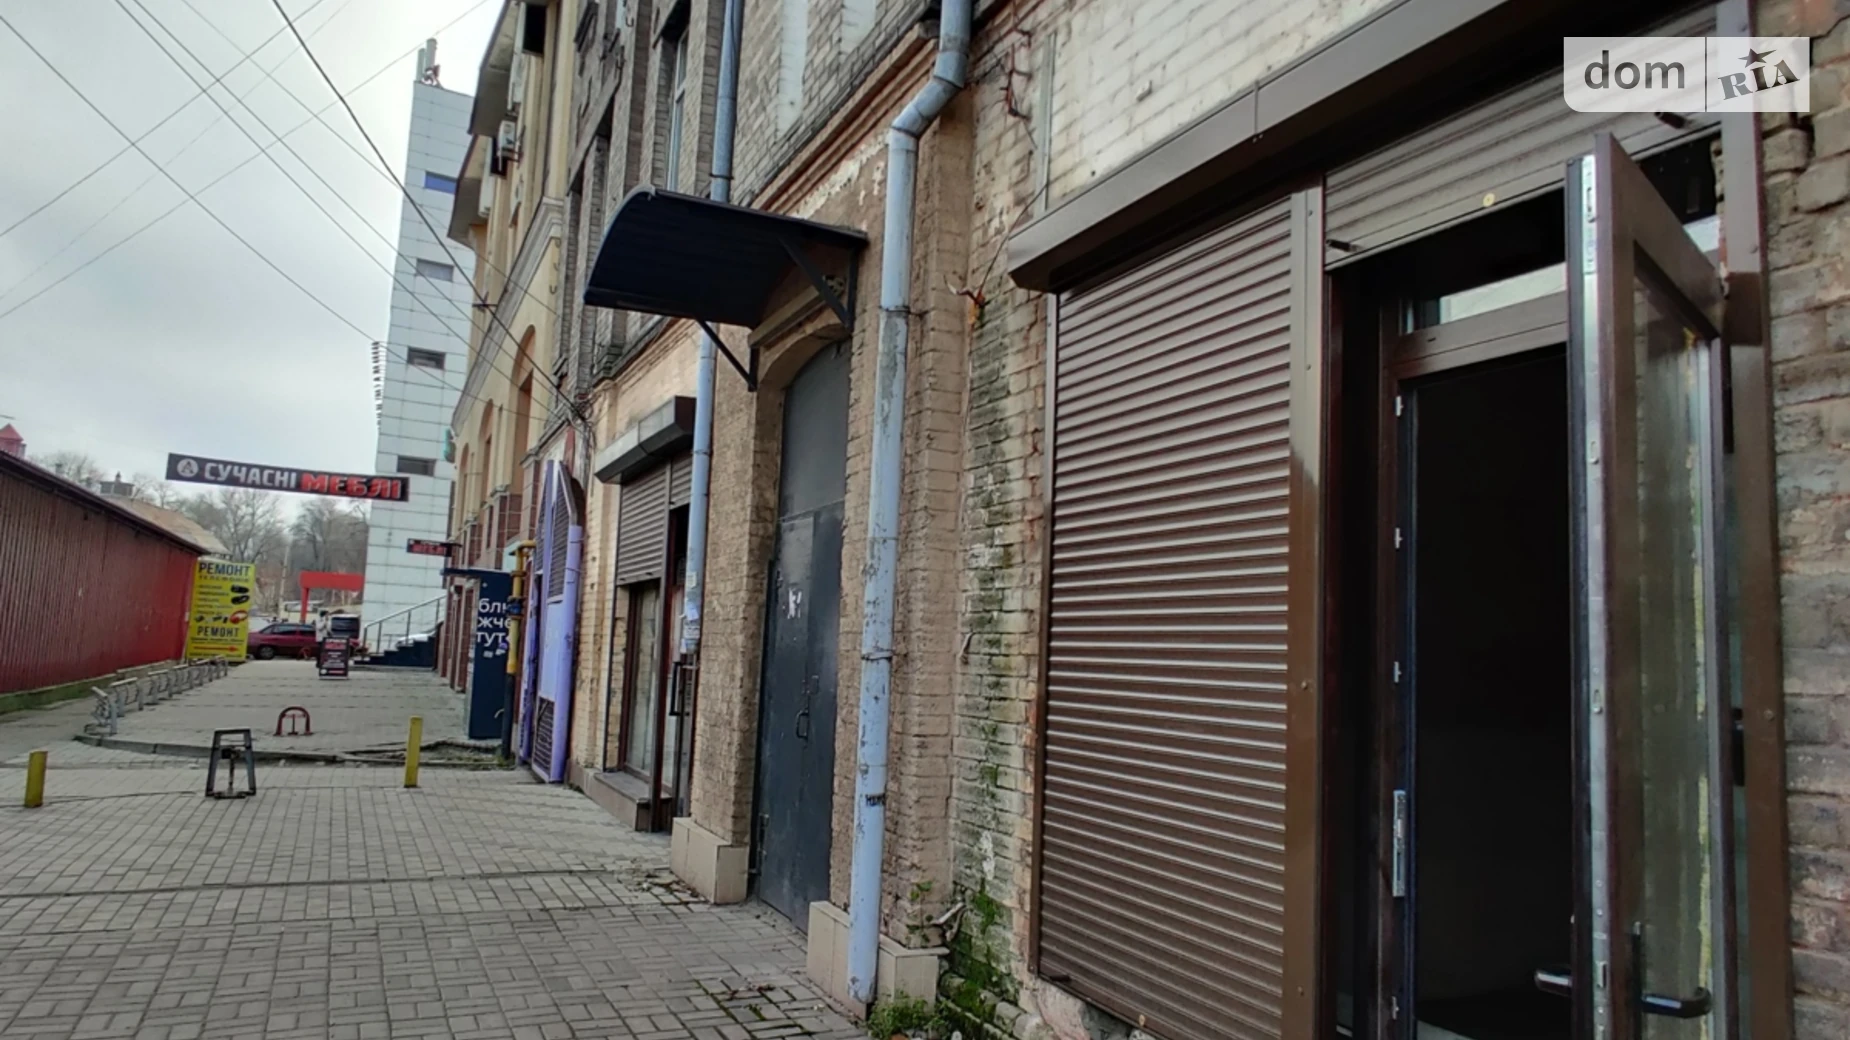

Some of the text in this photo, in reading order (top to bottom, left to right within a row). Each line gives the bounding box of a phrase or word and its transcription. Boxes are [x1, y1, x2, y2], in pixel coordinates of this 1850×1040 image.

[204, 462, 297, 488] СУЧАСНІ
[301, 473, 401, 499] МЕБЛІ
[198, 562, 251, 576] РЕМОНТ
[197, 626, 239, 637] РЕМОНТ
